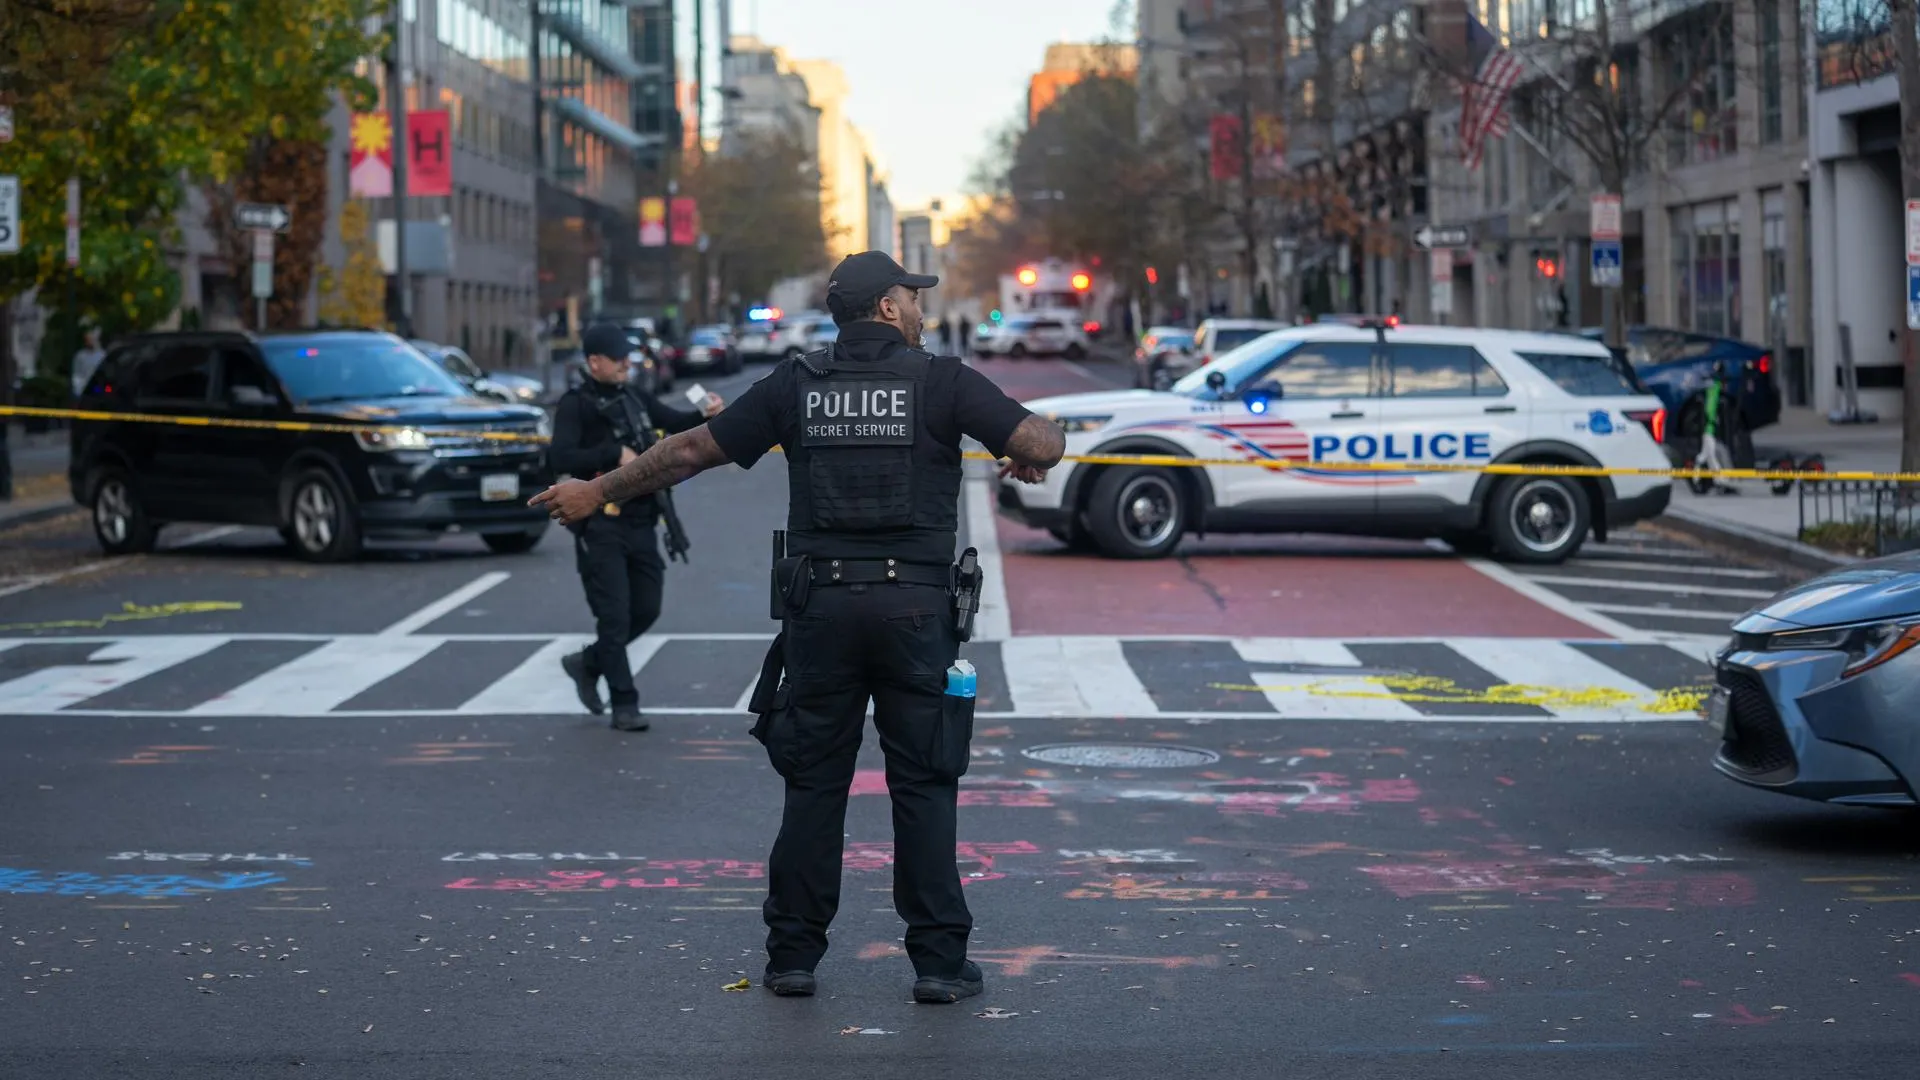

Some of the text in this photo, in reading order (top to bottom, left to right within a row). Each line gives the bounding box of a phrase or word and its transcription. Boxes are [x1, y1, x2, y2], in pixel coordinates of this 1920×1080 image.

[413, 129, 443, 162] H
[806, 389, 907, 419] POLICE
[807, 424, 906, 437] SECRET SERVICE
[1313, 432, 1491, 462] POLICE
